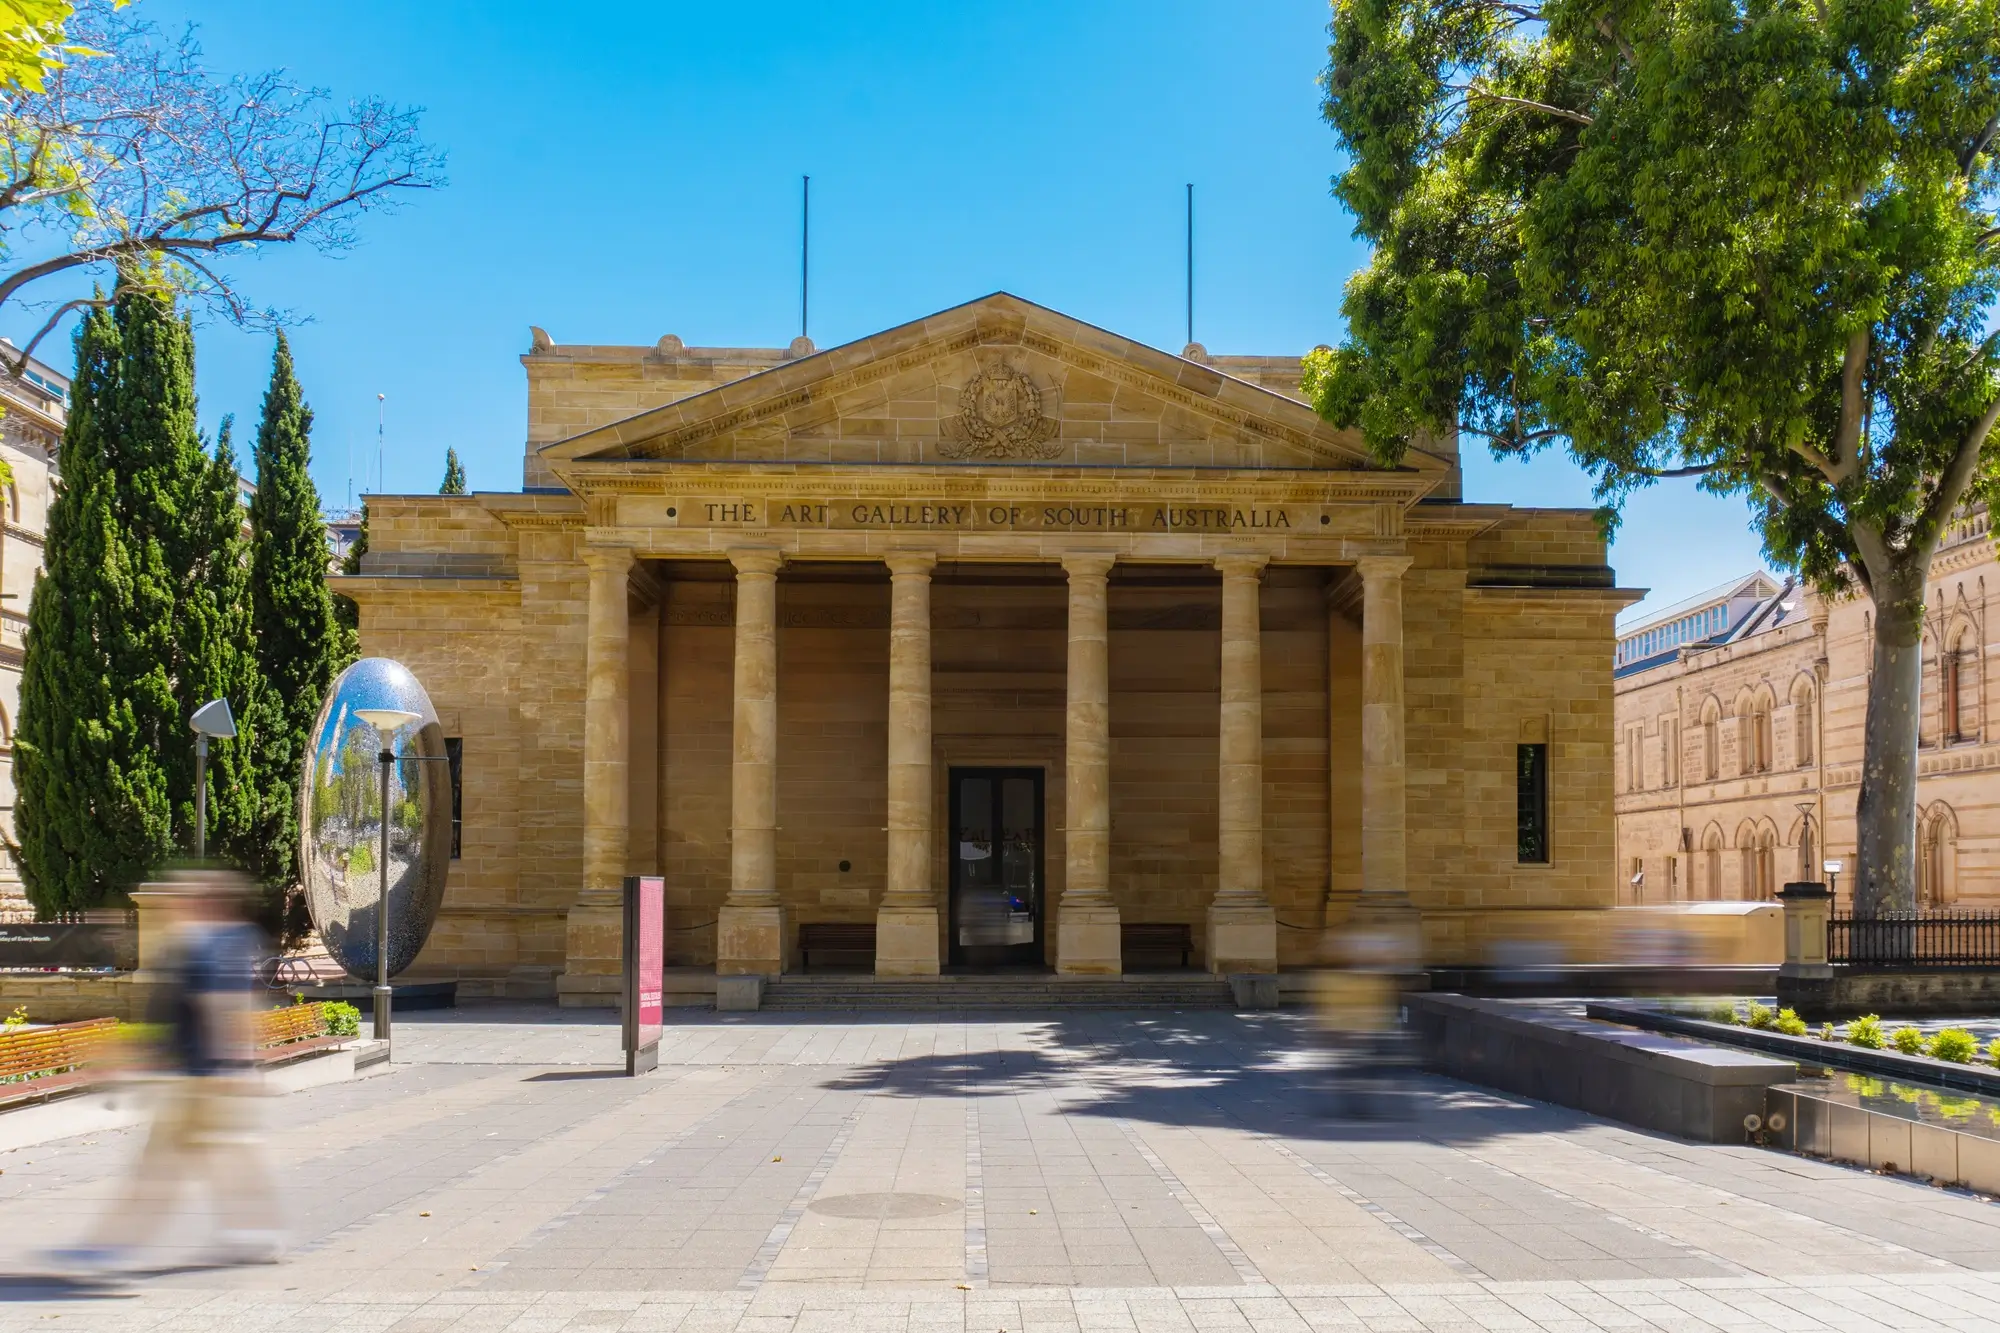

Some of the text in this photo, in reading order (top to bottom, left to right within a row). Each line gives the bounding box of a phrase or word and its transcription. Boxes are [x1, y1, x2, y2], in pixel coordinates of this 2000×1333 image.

[704, 503, 1292, 528] THE ART GALLERY OF SOUTH AUSTRALIA
